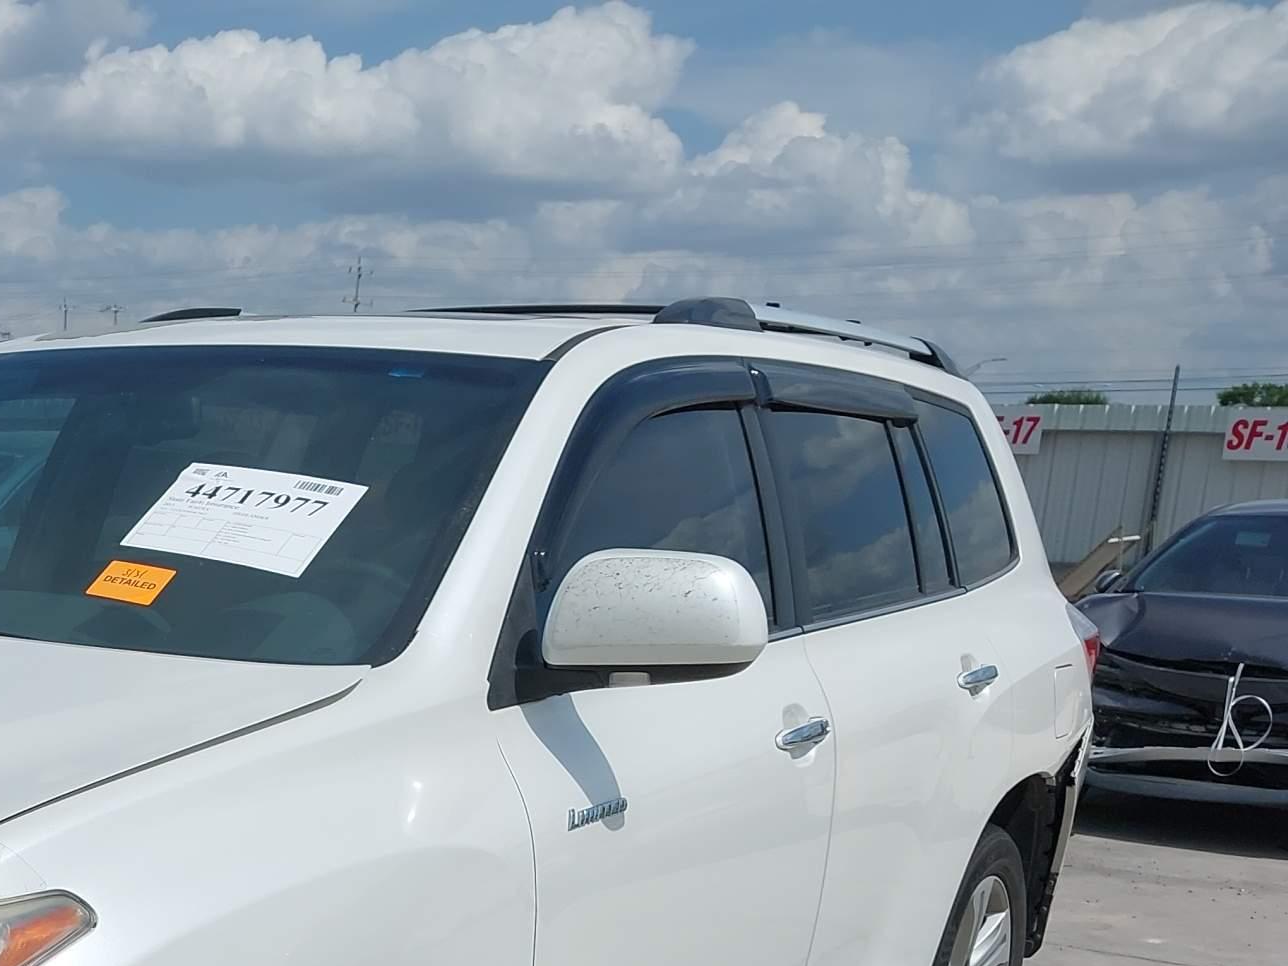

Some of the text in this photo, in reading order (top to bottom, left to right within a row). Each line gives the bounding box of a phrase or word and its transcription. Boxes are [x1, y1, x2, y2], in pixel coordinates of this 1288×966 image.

[1226, 419, 1288, 450] SF-1
[185, 483, 329, 517] 44717977
[103, 575, 157, 590] DETAILED
